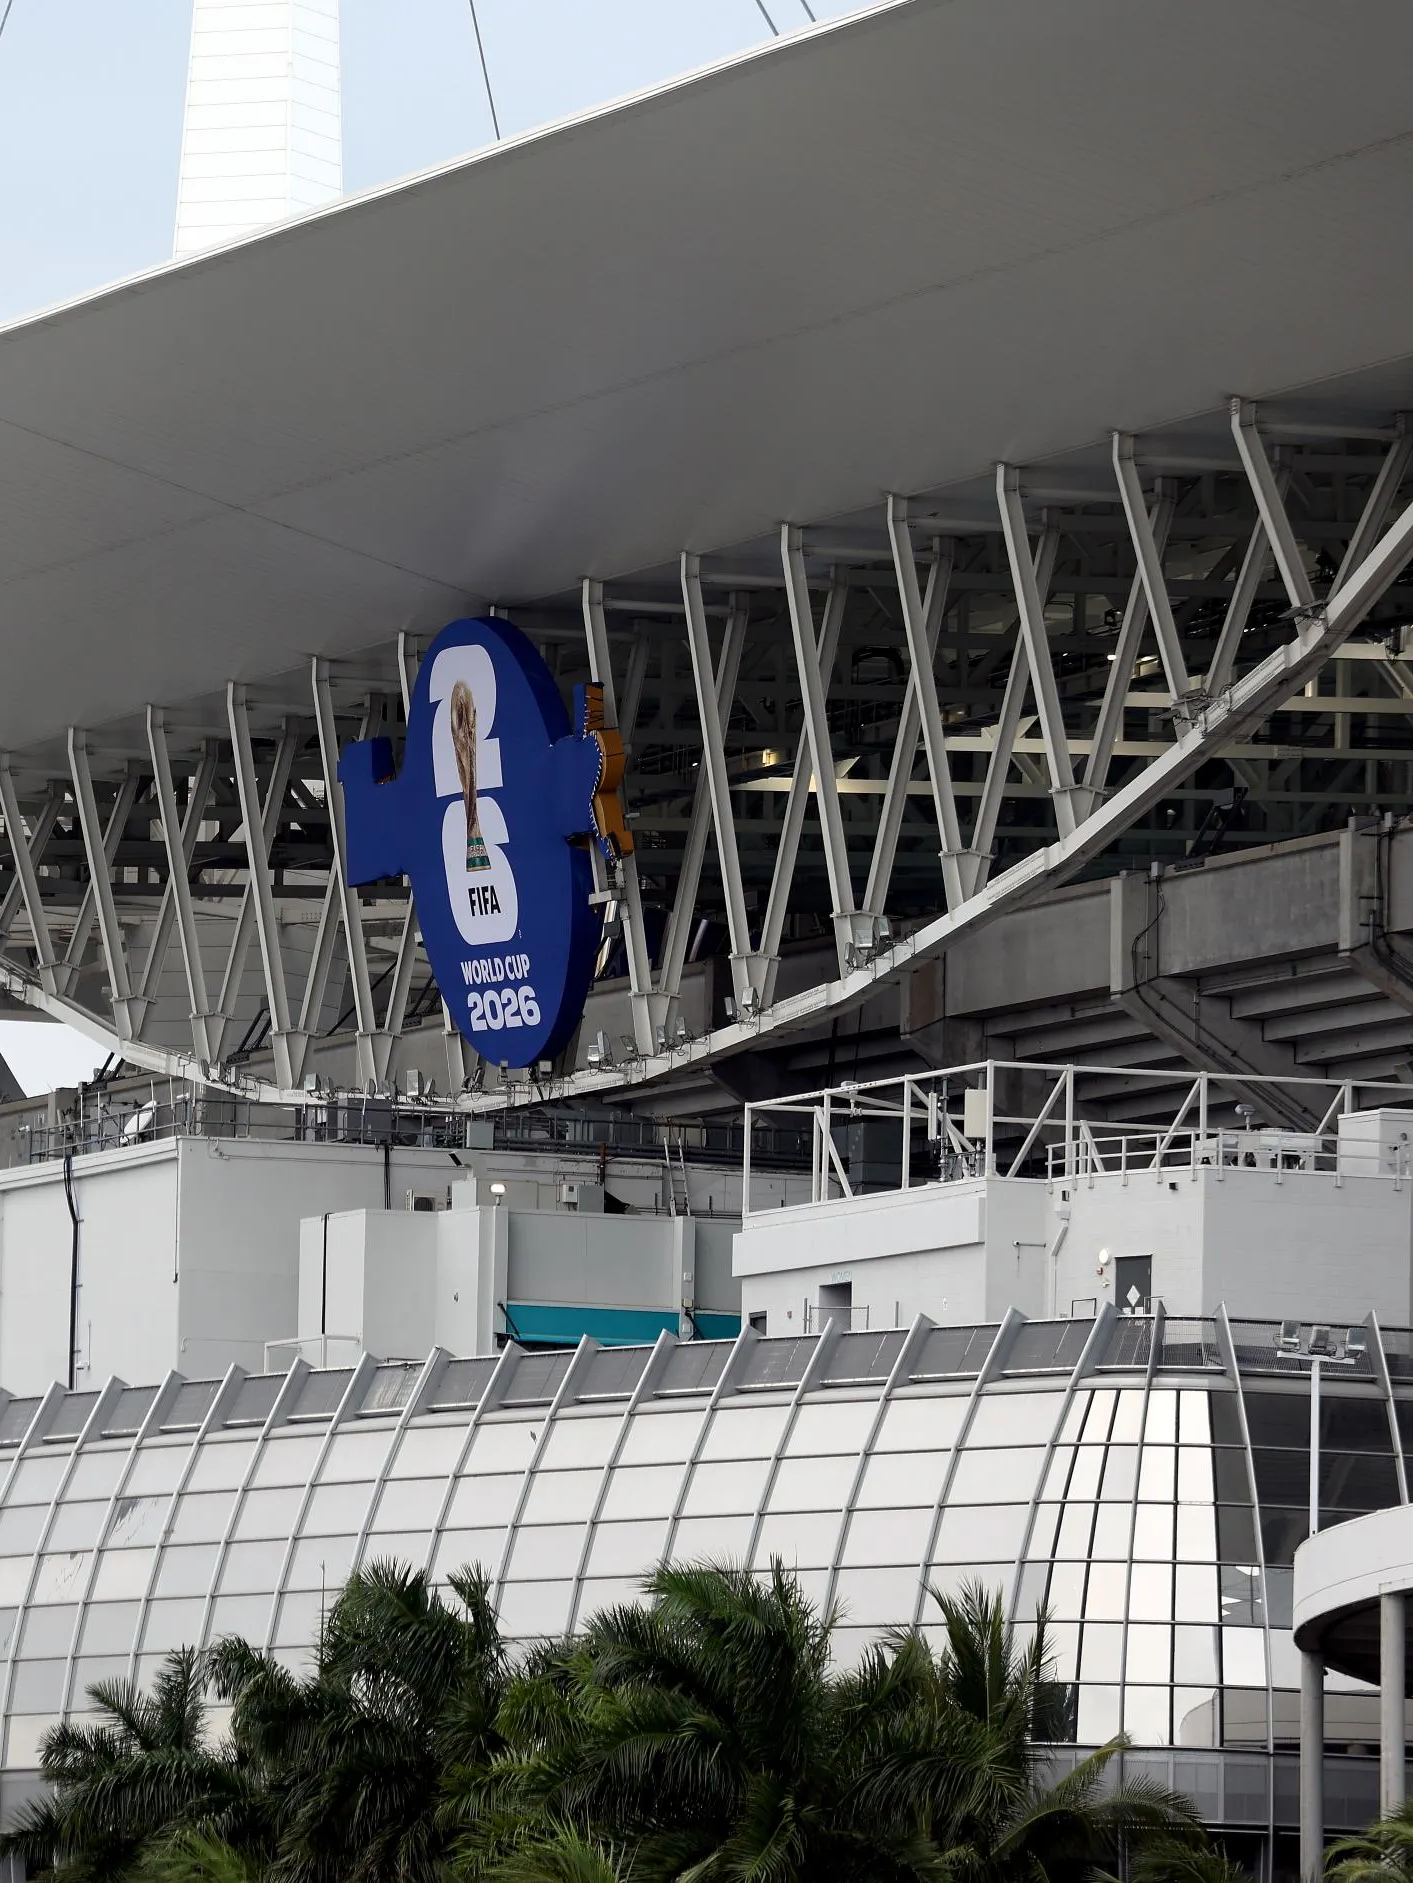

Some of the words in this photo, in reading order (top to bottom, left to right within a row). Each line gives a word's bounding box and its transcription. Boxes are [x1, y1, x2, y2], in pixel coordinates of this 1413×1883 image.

[468, 885, 501, 917] FIFA
[460, 957, 505, 986] WORLD
[504, 953, 530, 981] CUP
[467, 985, 541, 1032] 2026
